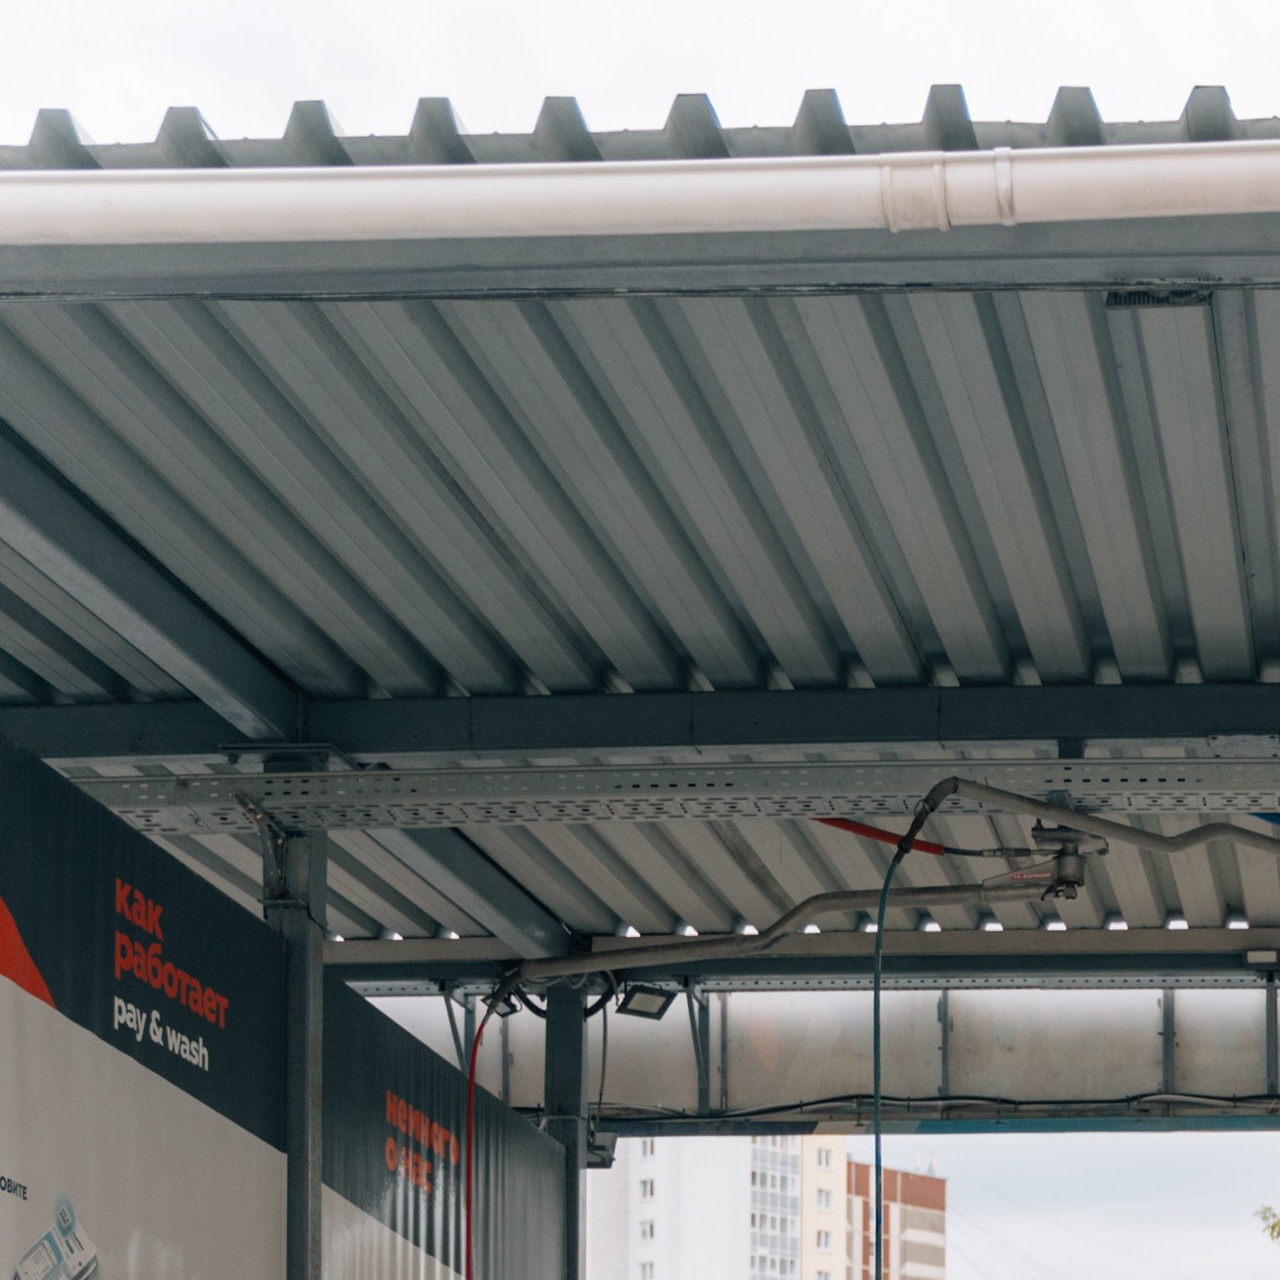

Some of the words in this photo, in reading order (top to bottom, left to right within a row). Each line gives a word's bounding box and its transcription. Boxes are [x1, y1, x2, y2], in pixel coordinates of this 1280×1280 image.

[115, 877, 164, 941] как
[115, 929, 229, 1029] работает
[114, 995, 147, 1043] pay
[149, 1009, 164, 1047] &
[166, 1024, 209, 1071] wash
[386, 1090, 459, 1167] немного
[402, 1145, 432, 1194] нас
